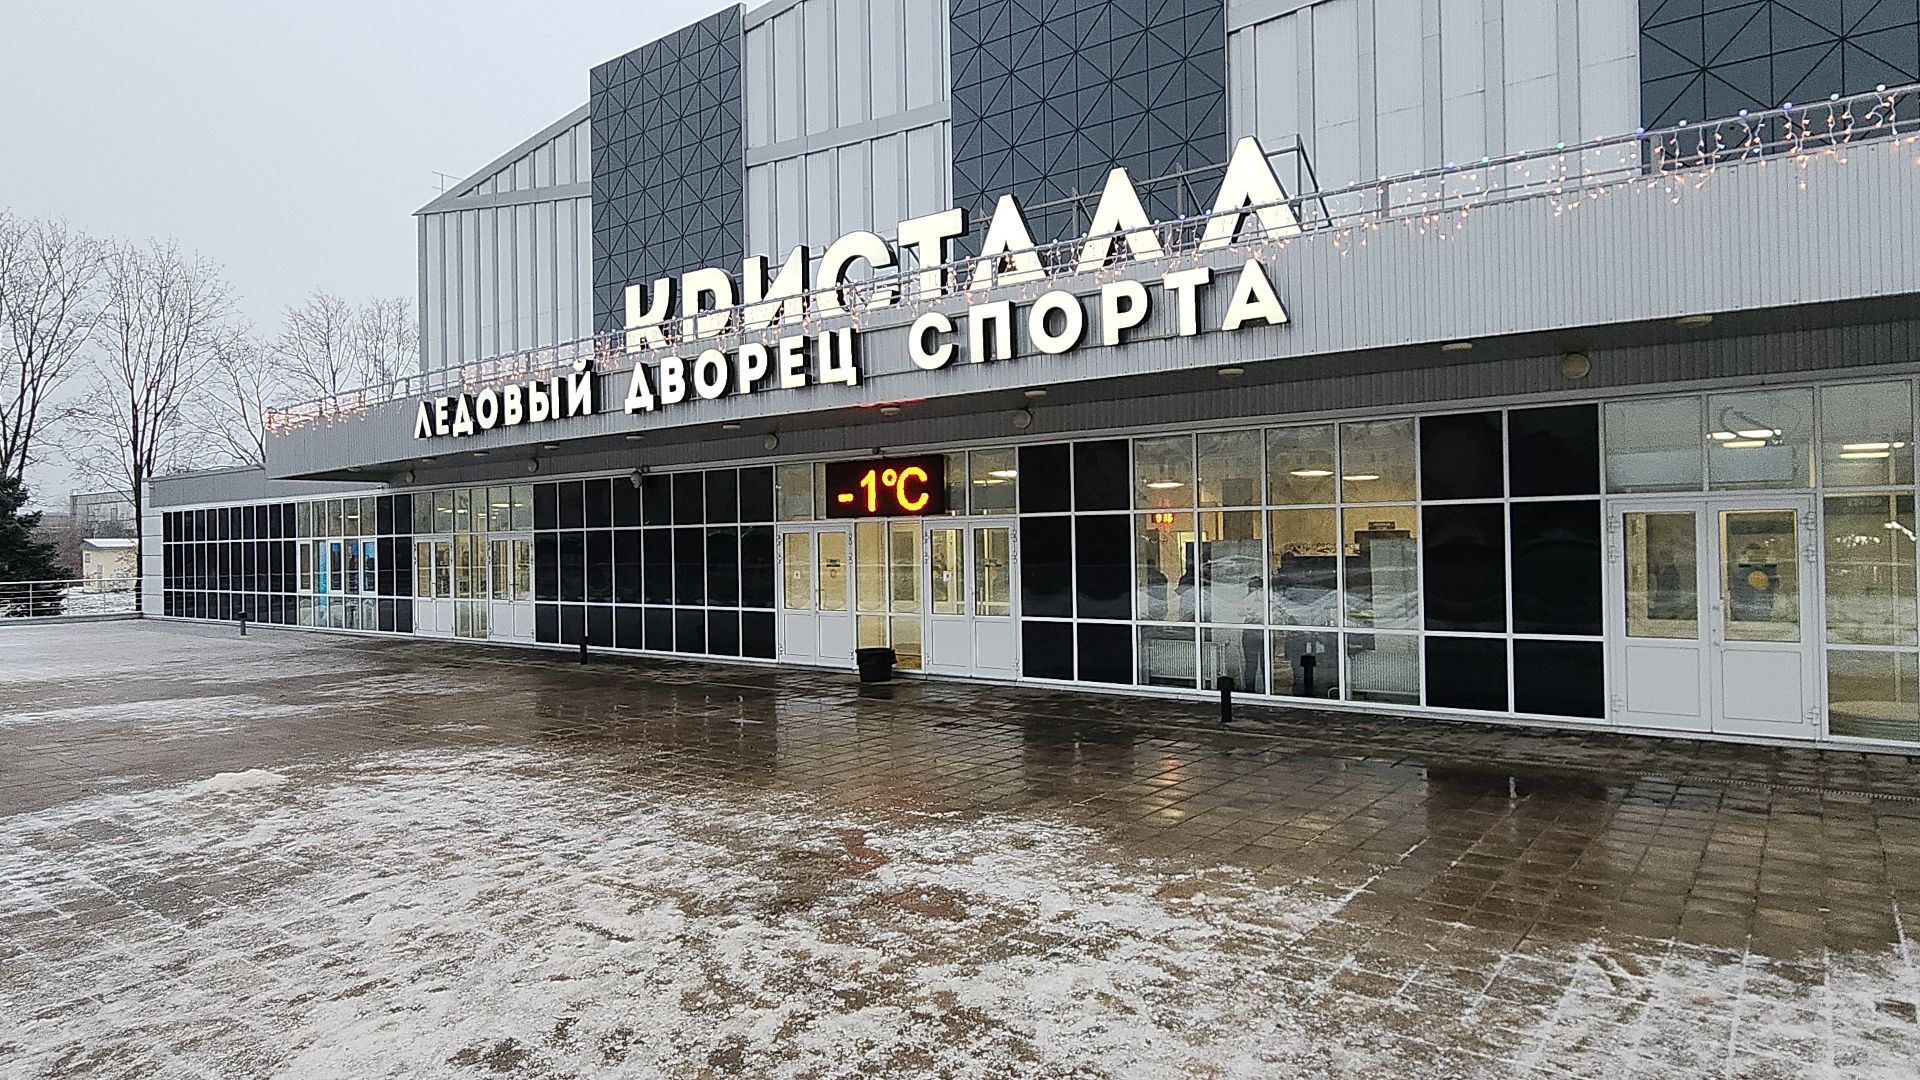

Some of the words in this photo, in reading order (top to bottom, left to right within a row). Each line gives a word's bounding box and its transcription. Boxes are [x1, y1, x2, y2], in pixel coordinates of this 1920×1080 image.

[624, 136, 1302, 354] КРИСТАЛЛ
[413, 359, 593, 440] ЛЕДОВЫЙ
[624, 326, 858, 415] ДВОРЕЦ
[908, 257, 1289, 371] СПОРТА
